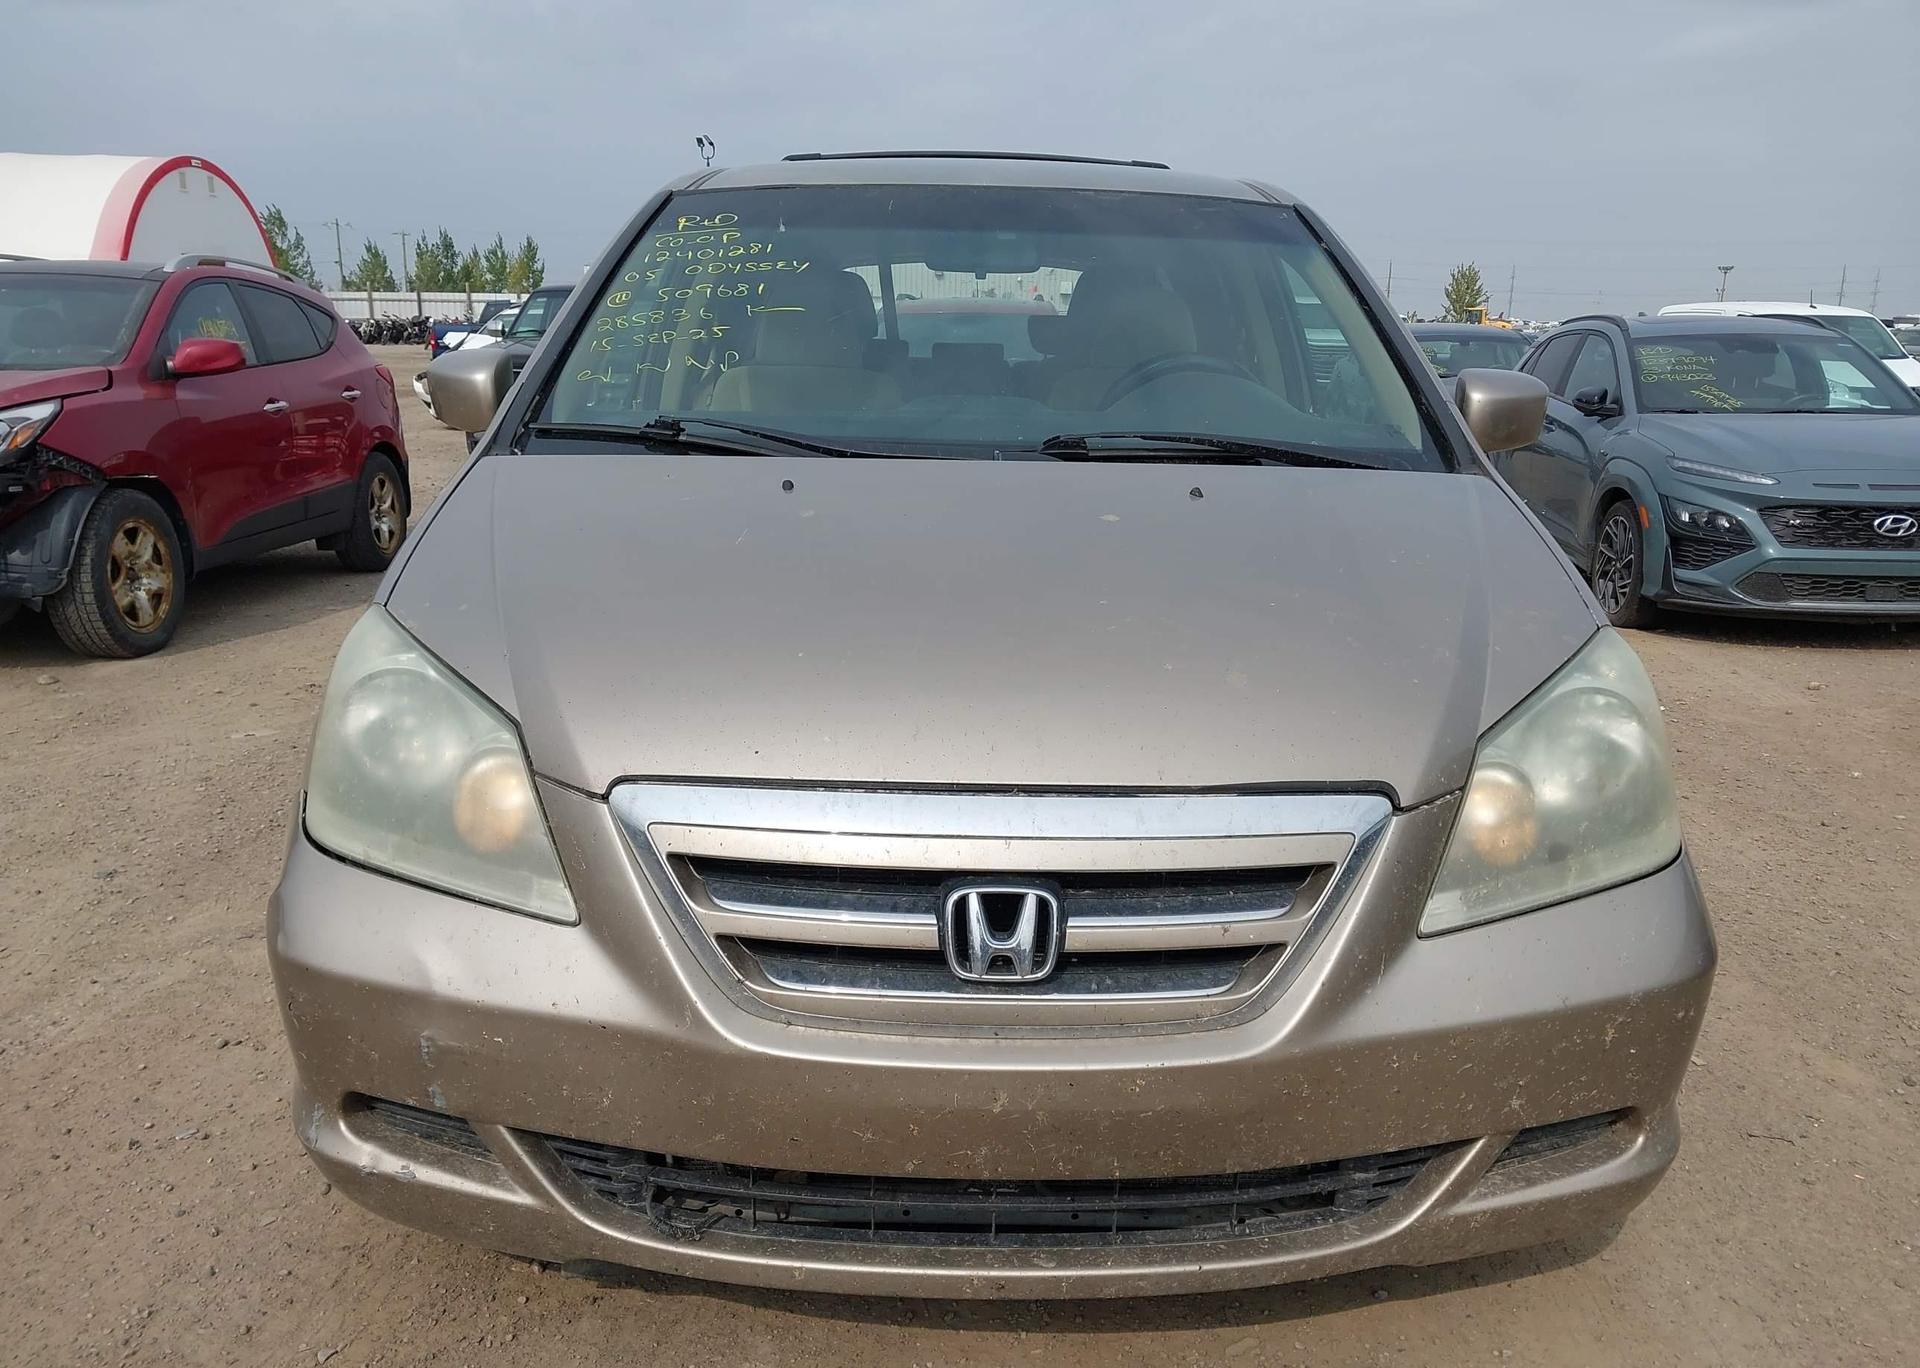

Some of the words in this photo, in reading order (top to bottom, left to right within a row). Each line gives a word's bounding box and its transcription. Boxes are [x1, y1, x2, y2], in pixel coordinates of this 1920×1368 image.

[644, 243, 773, 263] 12401281
[685, 260, 810, 275] ODYSSEY
[656, 283, 766, 302] 509681
[597, 307, 713, 332] 285836
